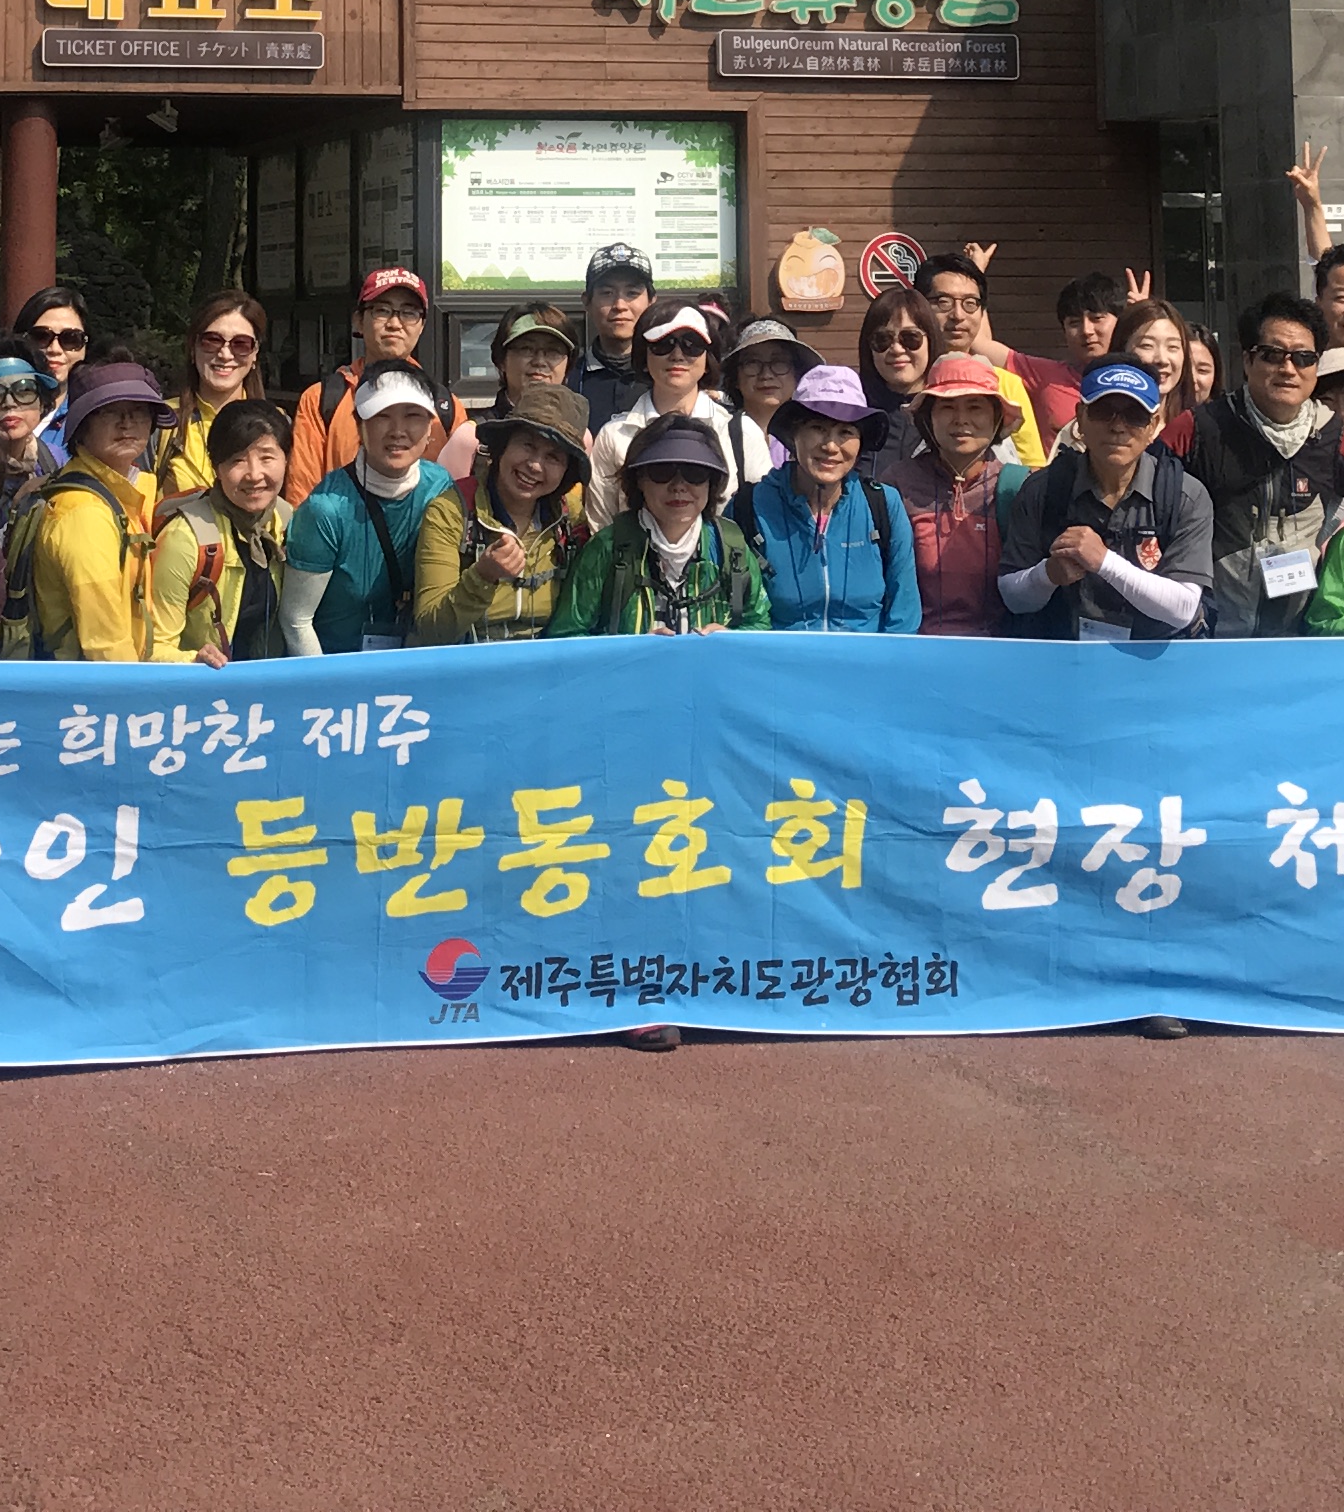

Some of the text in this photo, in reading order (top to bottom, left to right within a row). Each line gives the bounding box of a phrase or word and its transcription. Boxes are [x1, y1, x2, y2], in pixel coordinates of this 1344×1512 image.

[56, 39, 116, 55] TICKET
[120, 40, 180, 57] OFFICE
[196, 42, 249, 58] チケット
[732, 35, 1007, 54] BulgeunOreum Natural Recreation Forest
[59, 699, 275, 777] 희망찬
[302, 695, 431, 766] 제주
[227, 780, 866, 926] 등반동호회
[942, 778, 1208, 914] 현장
[499, 952, 958, 1008] 제주특별자치도관광협회
[428, 1002, 480, 1026] JTA
